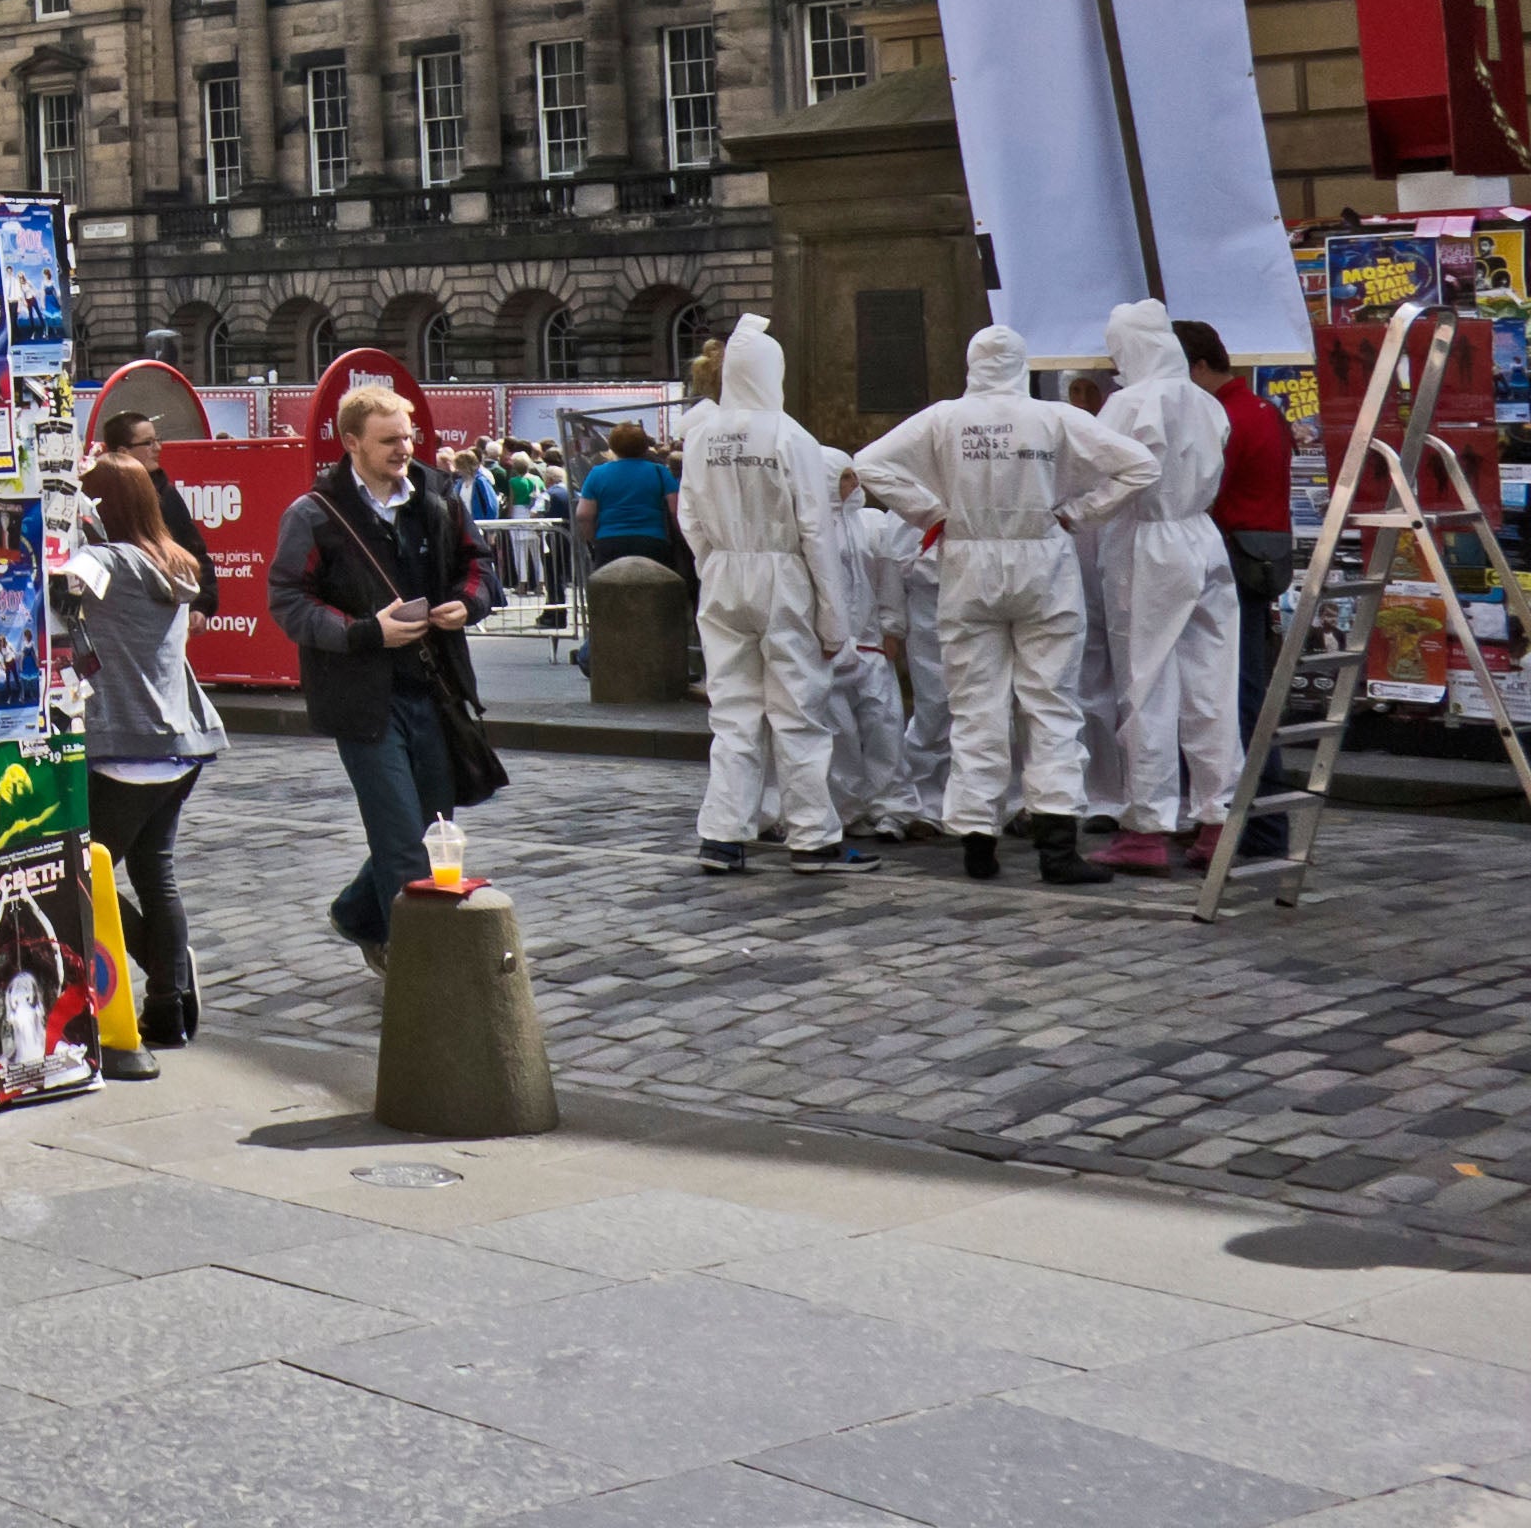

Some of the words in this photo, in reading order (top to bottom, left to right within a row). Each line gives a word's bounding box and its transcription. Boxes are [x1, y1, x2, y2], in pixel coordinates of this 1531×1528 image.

[1341, 261, 1417, 285] MOSCOW
[1363, 274, 1410, 295] STATE
[961, 438, 999, 450] CLASS
[225, 549, 250, 566] joins
[252, 551, 265, 563] in,
[234, 564, 254, 578] off.
